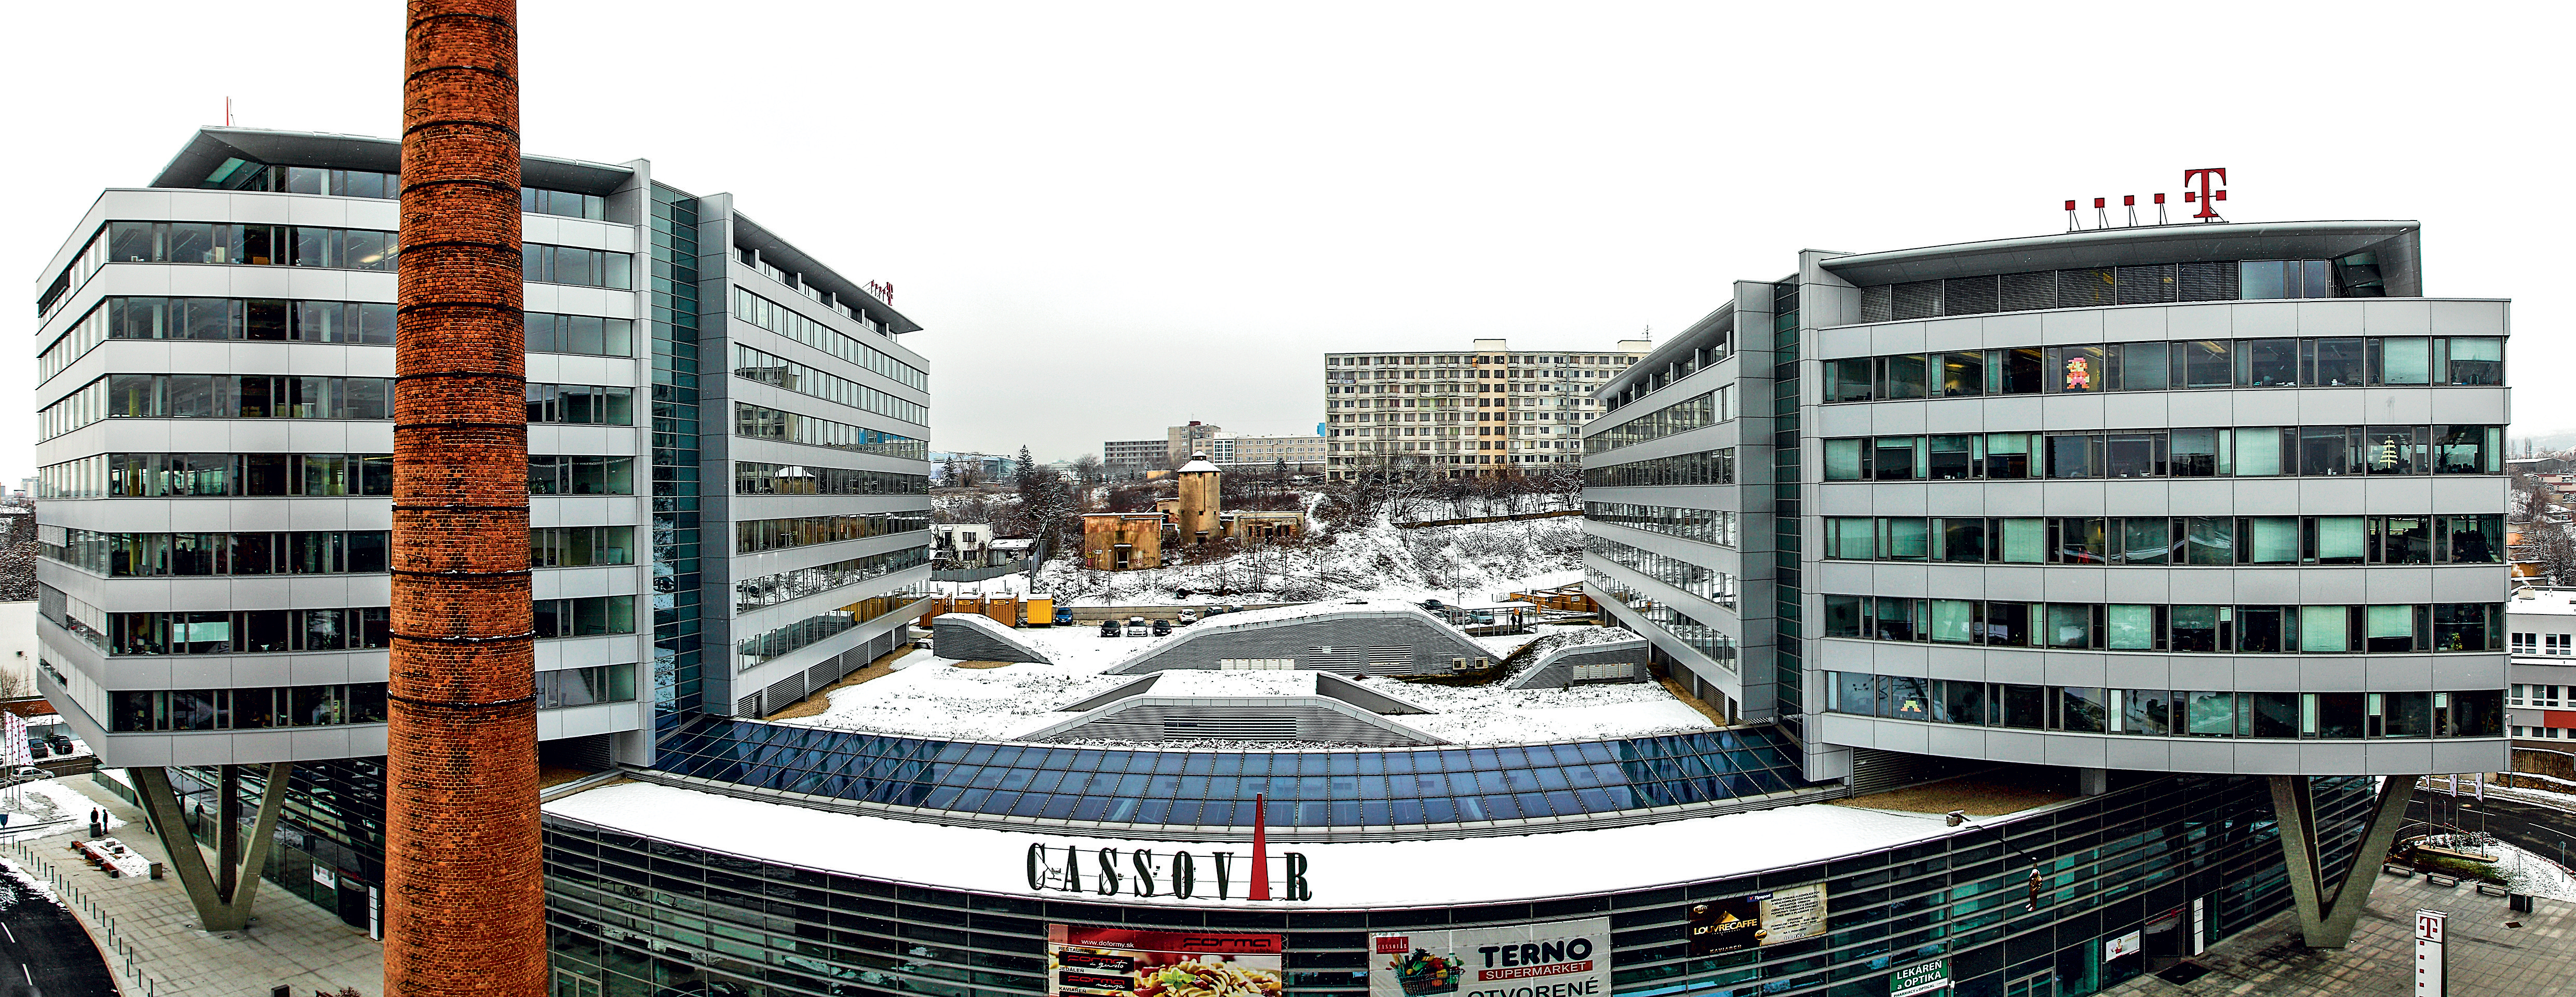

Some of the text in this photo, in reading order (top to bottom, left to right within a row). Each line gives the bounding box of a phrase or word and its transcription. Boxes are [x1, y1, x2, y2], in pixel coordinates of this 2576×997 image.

[2185, 168, 2227, 218] T
[1081, 939, 1135, 949] www.doformy.sk
[1478, 937, 1593, 968] TERNO
[1486, 962, 1586, 979] SUPERMARKET
[1897, 959, 1942, 980] LEKÁREŇ
[1904, 971, 1941, 988] OPTIKA
[1894, 989, 1916, 997] PHARMACY
